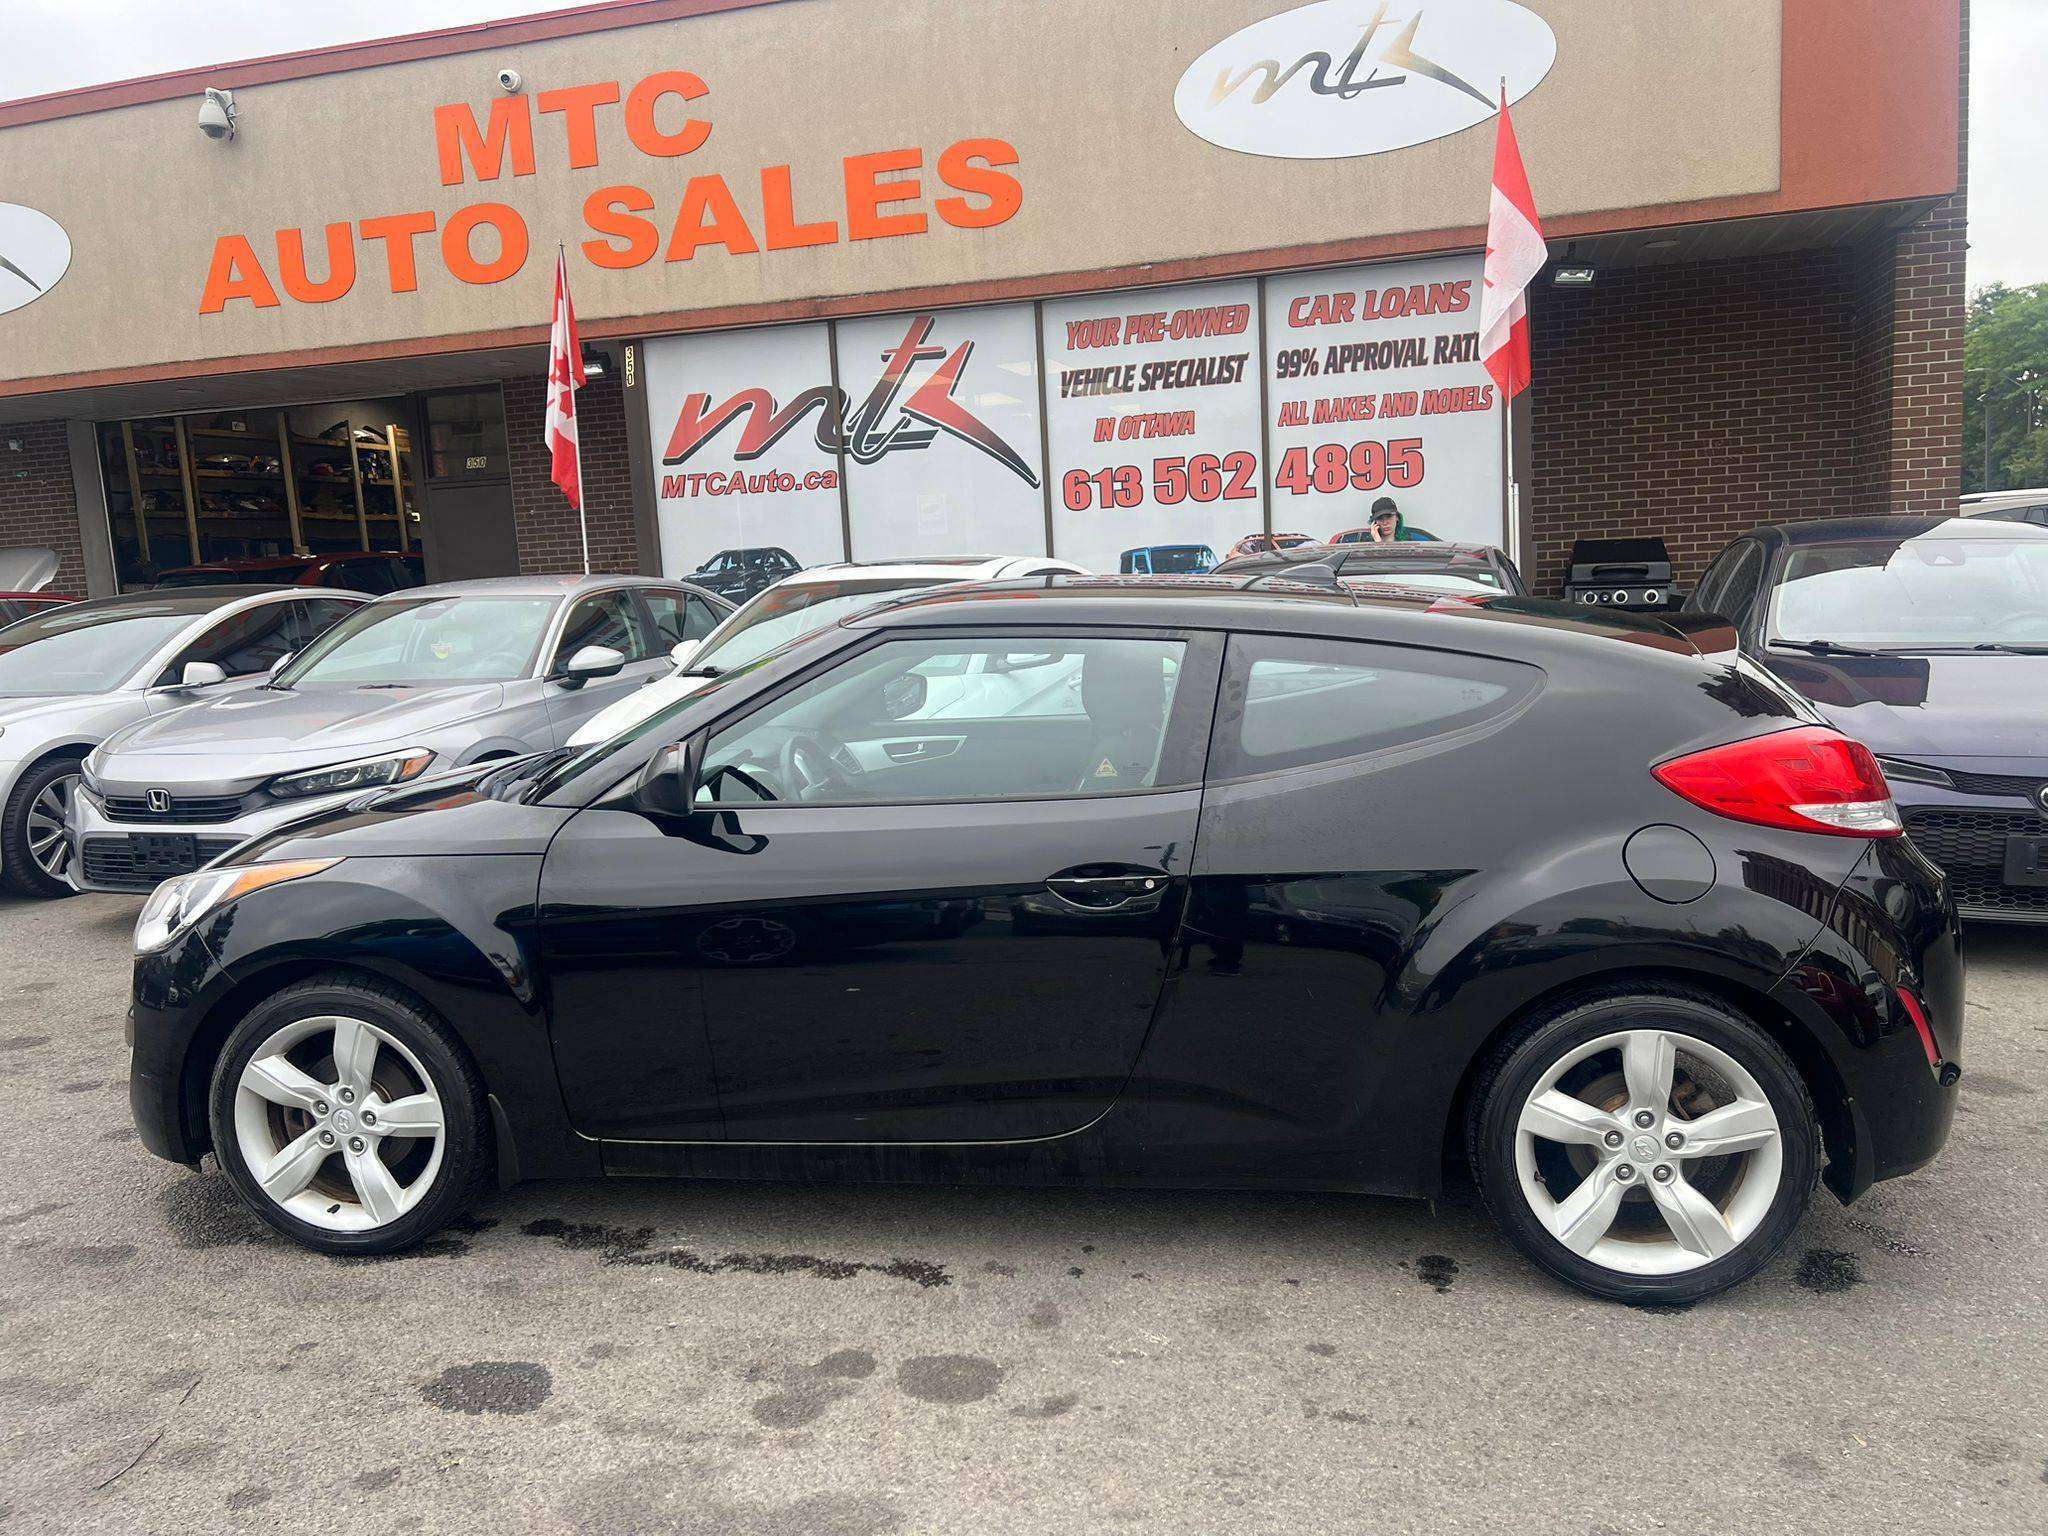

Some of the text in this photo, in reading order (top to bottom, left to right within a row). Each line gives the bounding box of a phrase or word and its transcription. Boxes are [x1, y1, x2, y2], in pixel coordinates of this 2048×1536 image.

[434, 71, 713, 186] MTC
[199, 137, 1024, 315] AUTO SALES
[1065, 303, 1250, 350] YOUR PRE-OWNED
[1288, 280, 1472, 328] CAR LOANS
[625, 346, 634, 386] 350
[1060, 352, 1250, 398] VEHICLE SPECIALIST
[1276, 346, 1319, 379] 99%
[1323, 336, 1430, 375] APPROVAL
[1093, 410, 1195, 442] IN OTTAWA
[1278, 384, 1493, 427] ALL MAKES AND MODELS
[661, 468, 838, 499] MTCAuto.ca
[1063, 437, 1425, 511] 613 562 4895
